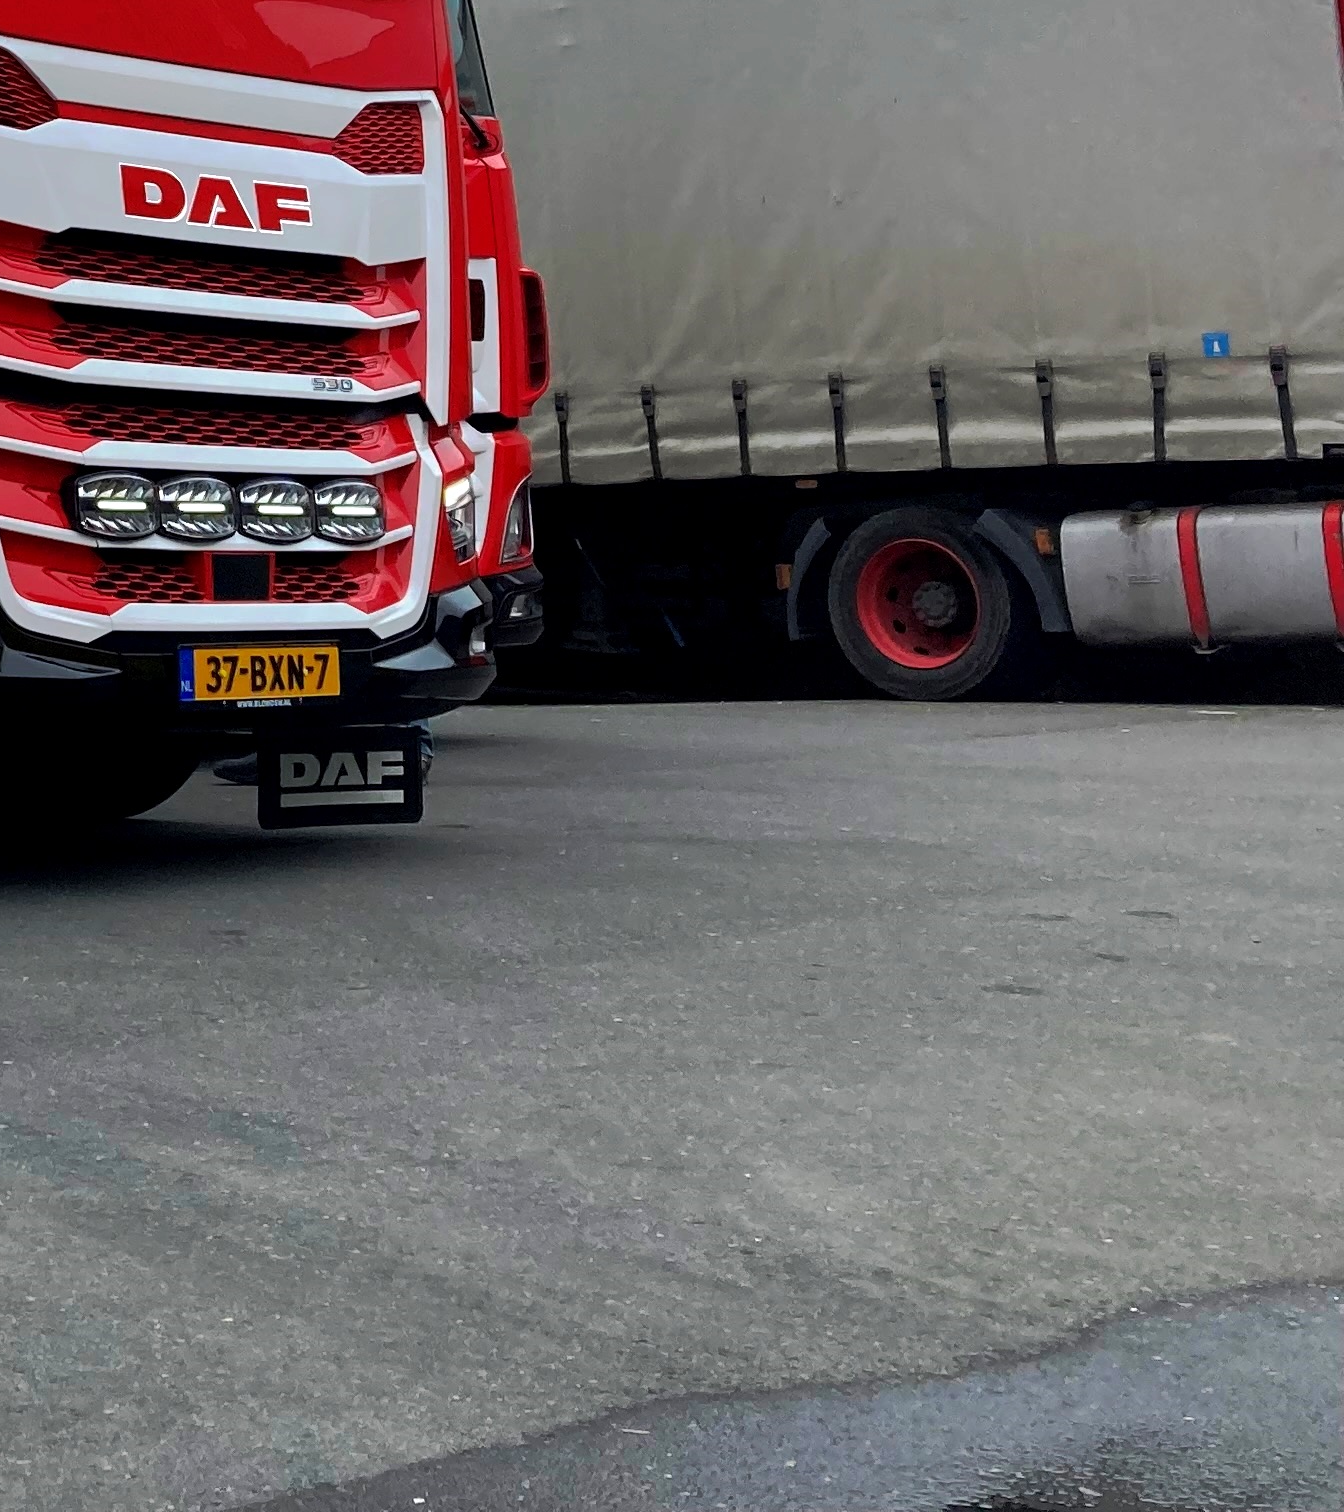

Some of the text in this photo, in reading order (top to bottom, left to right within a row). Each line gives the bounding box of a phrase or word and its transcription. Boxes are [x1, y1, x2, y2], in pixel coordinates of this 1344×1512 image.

[118, 162, 313, 235] DAF
[312, 377, 353, 393] 530
[180, 680, 194, 692] NL
[206, 654, 330, 694] 37-BXN-7
[278, 750, 404, 788] DAF
